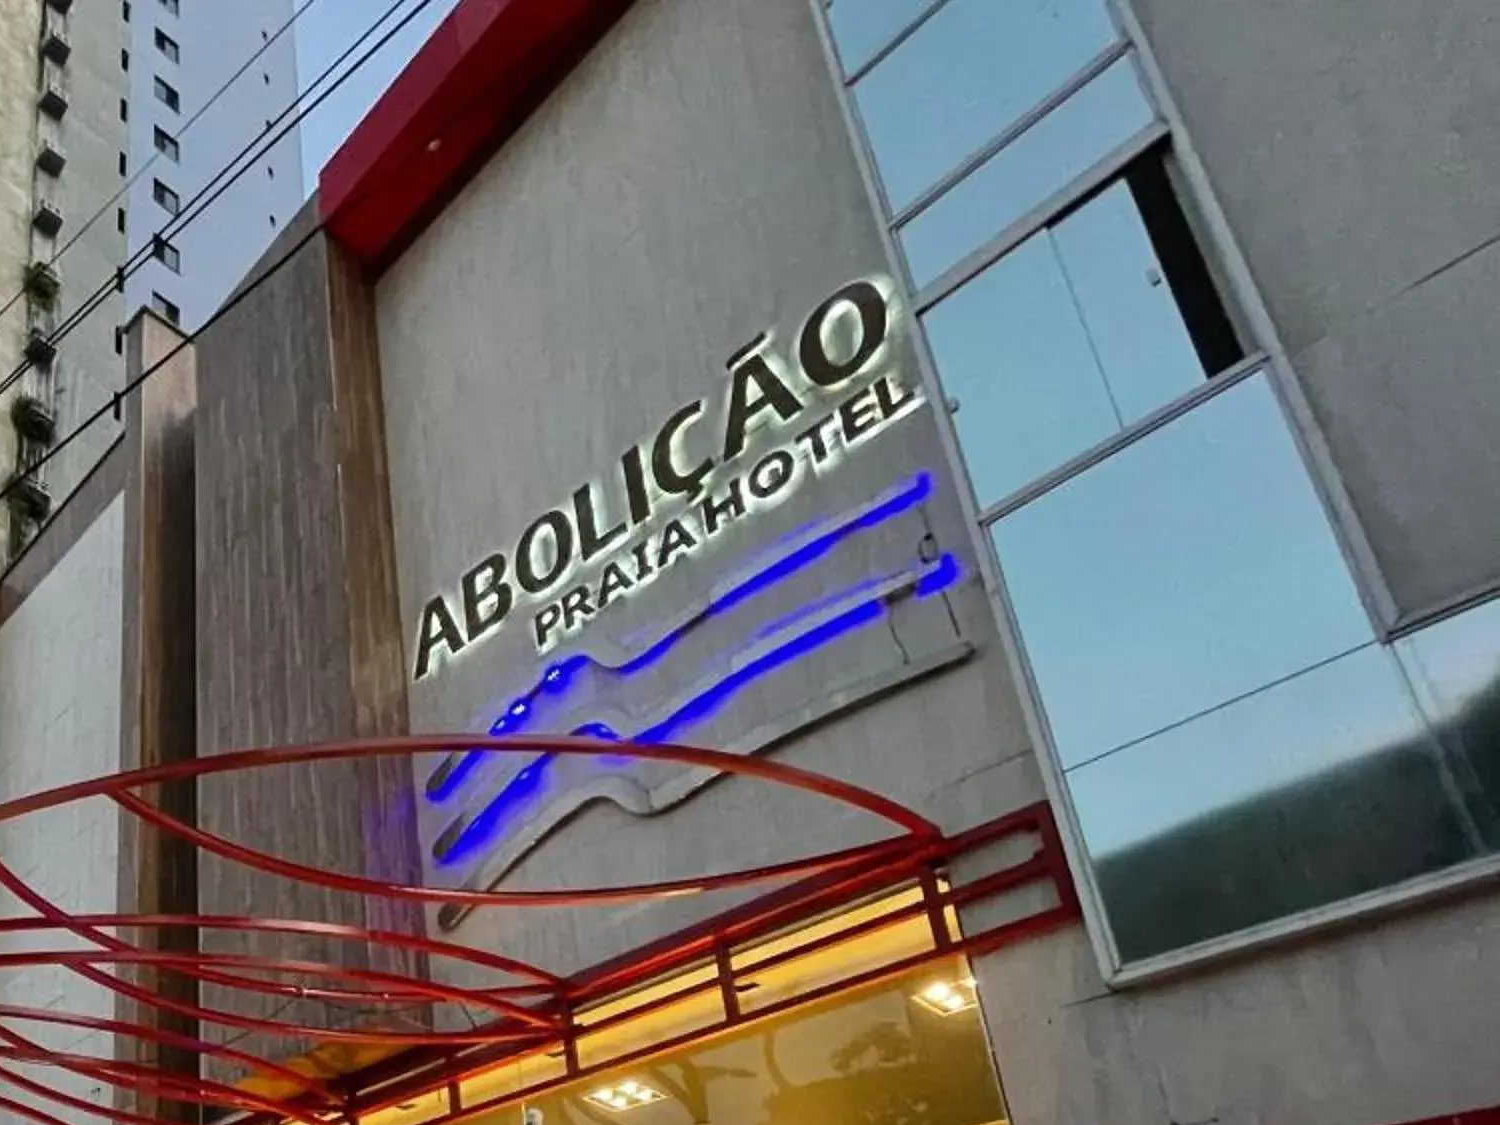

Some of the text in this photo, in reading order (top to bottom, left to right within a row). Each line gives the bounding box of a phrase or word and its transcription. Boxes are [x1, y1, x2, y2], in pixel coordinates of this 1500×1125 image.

[414, 281, 888, 681] ABOLIÇÃO
[535, 375, 916, 650] PRAIA HOTEL
